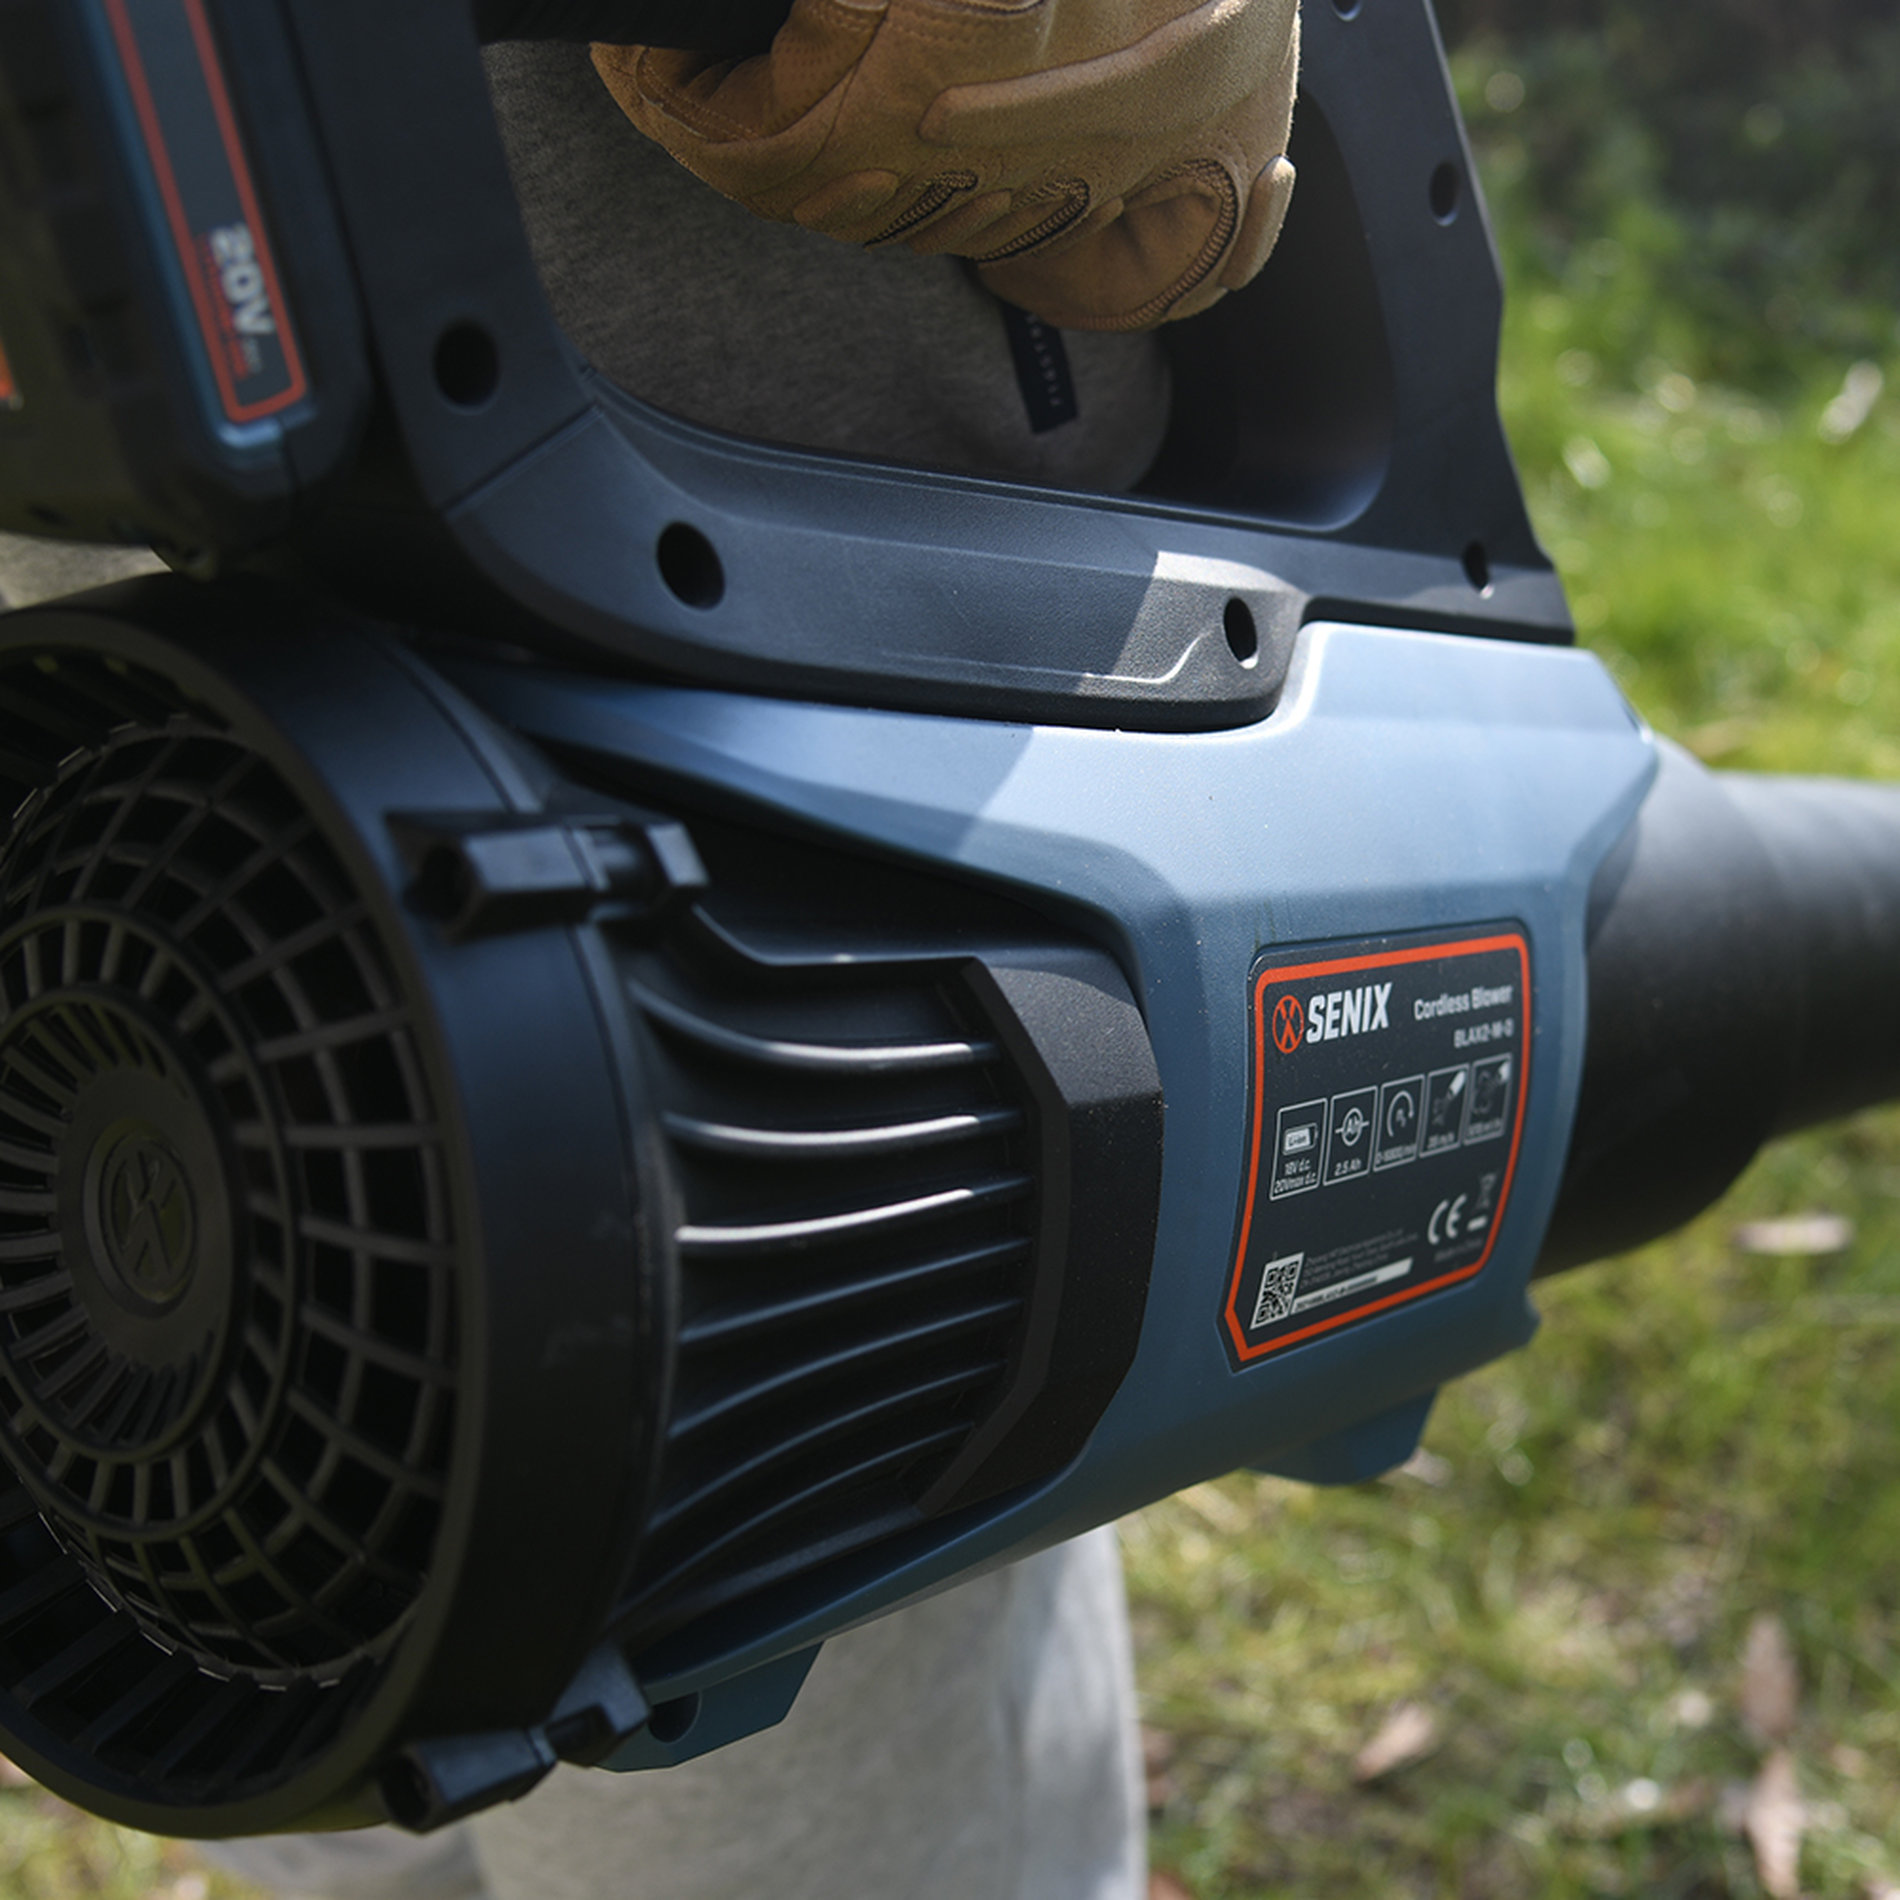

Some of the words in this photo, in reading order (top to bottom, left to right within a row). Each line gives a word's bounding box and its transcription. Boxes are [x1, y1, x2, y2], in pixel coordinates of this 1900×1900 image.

[209, 222, 276, 334] 20V
[1306, 982, 1392, 1044] SENIX
[1413, 990, 1470, 1021] Cordless
[1471, 984, 1514, 1010] Blower
[1427, 1193, 1467, 1246] CE
